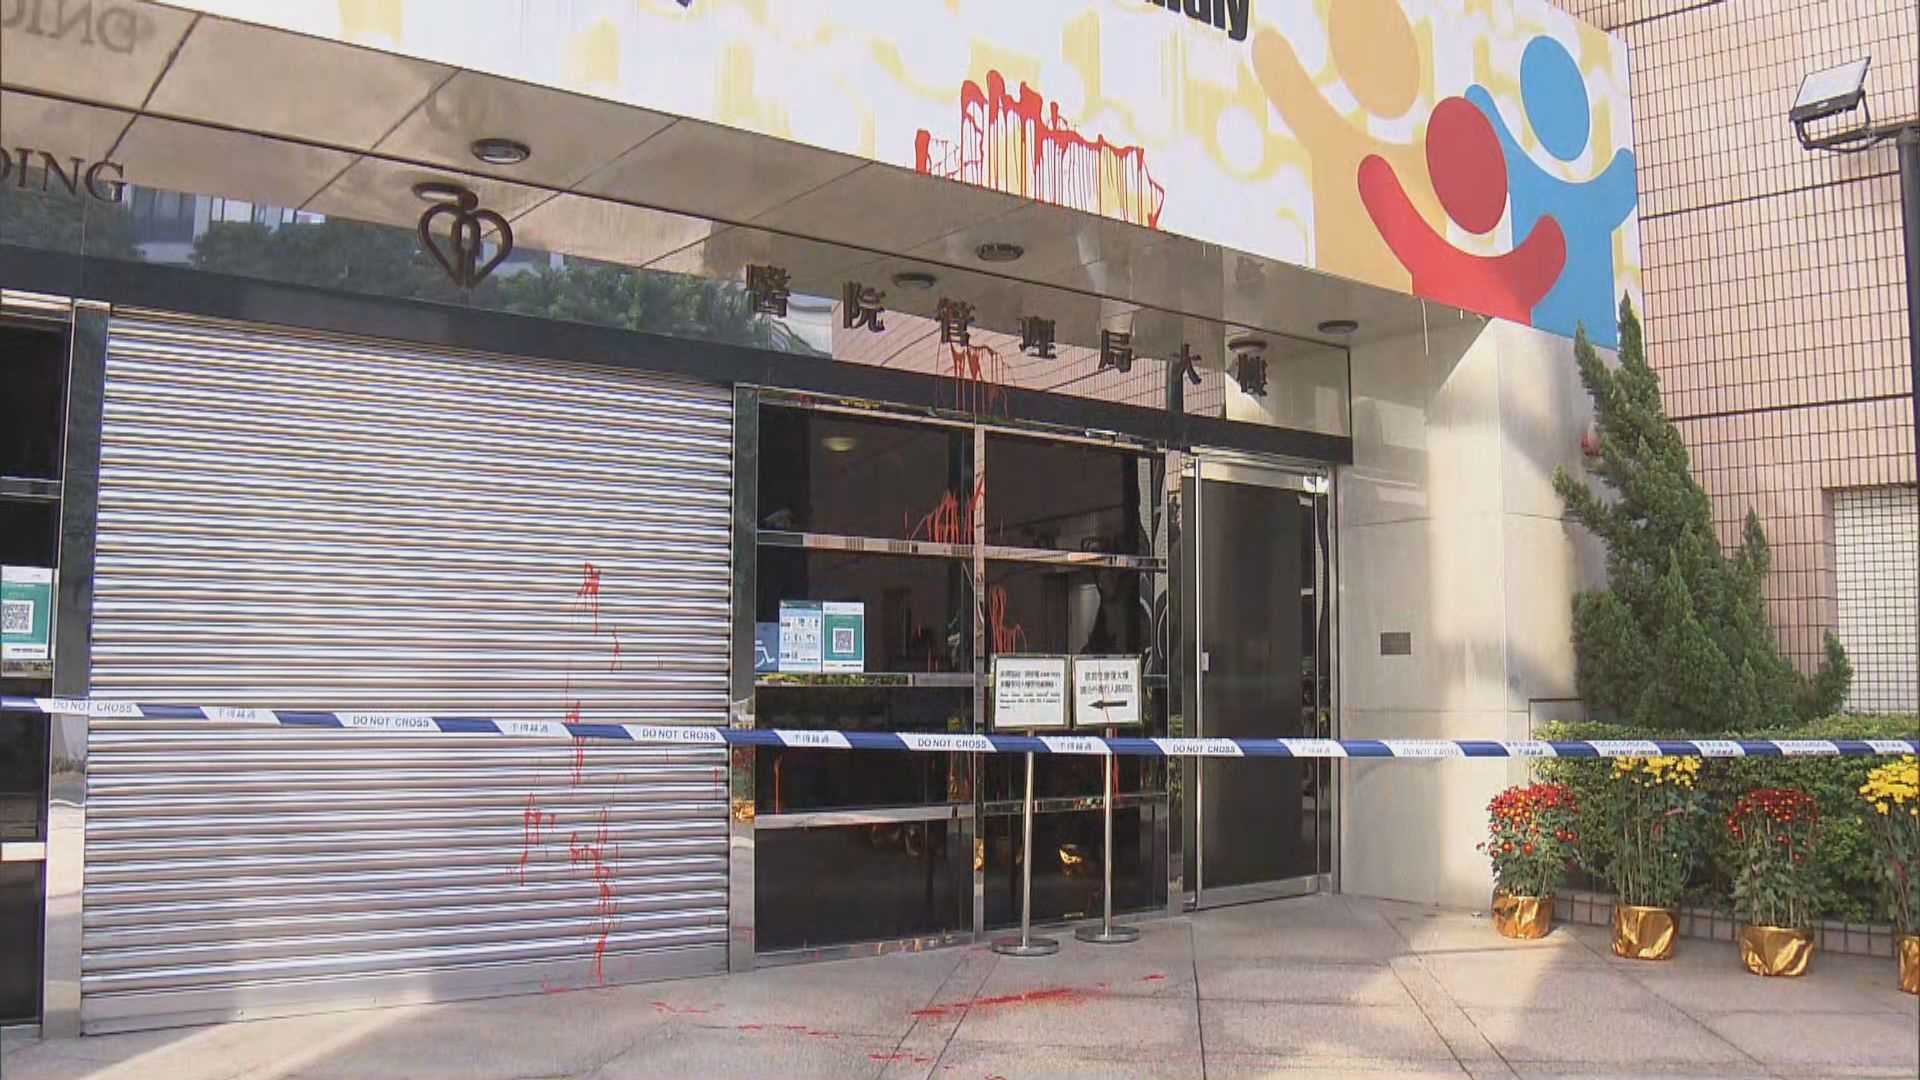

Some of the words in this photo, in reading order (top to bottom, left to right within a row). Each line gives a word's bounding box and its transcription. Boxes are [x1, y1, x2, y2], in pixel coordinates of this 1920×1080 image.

[745, 263, 1268, 397] 醫院管理局大樓
[53, 701, 69, 711] DO
[70, 702, 91, 712] NOT
[97, 703, 132, 714] CROSS
[353, 715, 367, 725] DO
[370, 716, 390, 726] NOT
[395, 717, 429, 728] CROSS
[642, 728, 657, 738] DO
[659, 729, 679, 739] NOT
[683, 730, 715, 741] CROSS
[917, 738, 931, 748] DO
[933, 739, 951, 748] NOT
[956, 739, 987, 750] CROSS
[1172, 745, 1185, 753] DO
[1186, 745, 1203, 753] NOT
[1207, 746, 1236, 754] CROSS
